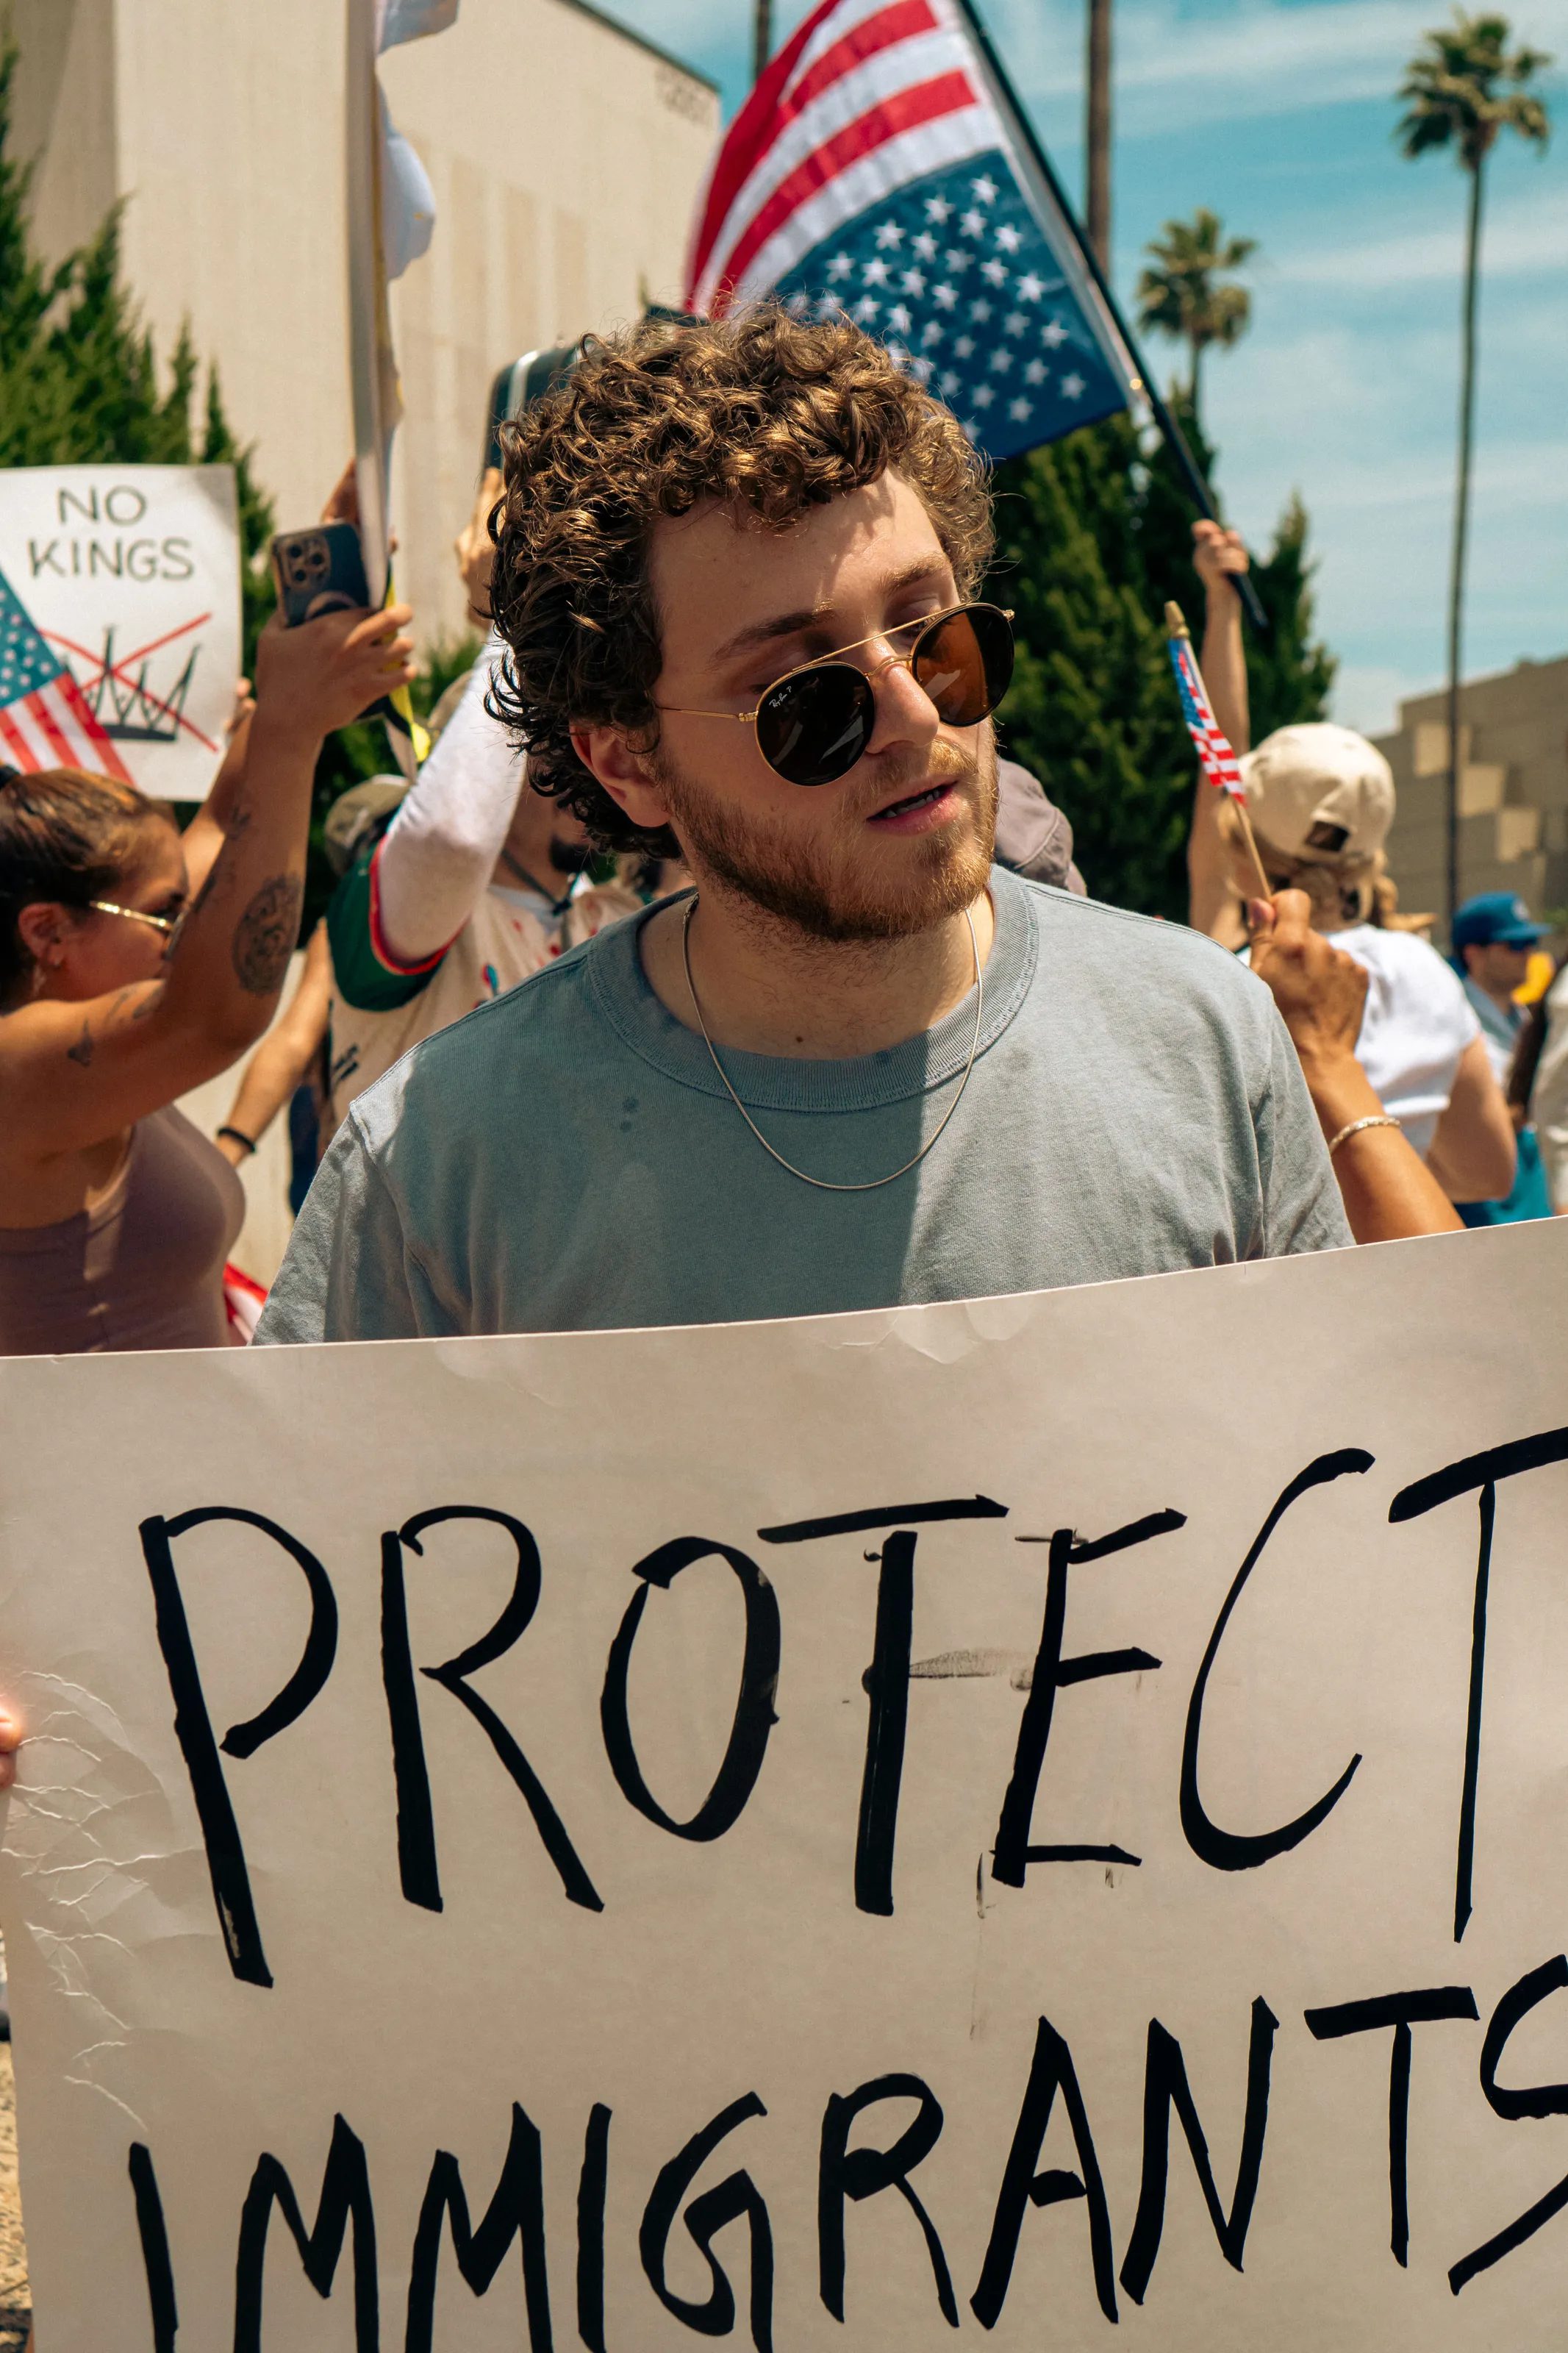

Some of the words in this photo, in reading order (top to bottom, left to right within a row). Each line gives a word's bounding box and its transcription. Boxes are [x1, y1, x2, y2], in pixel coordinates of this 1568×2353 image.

[28, 536, 194, 582] KINGS
[57, 485, 147, 527] NO
[138, 1427, 1568, 1988] PROTECT
[129, 1954, 1568, 2353] IMMIGRANTS
